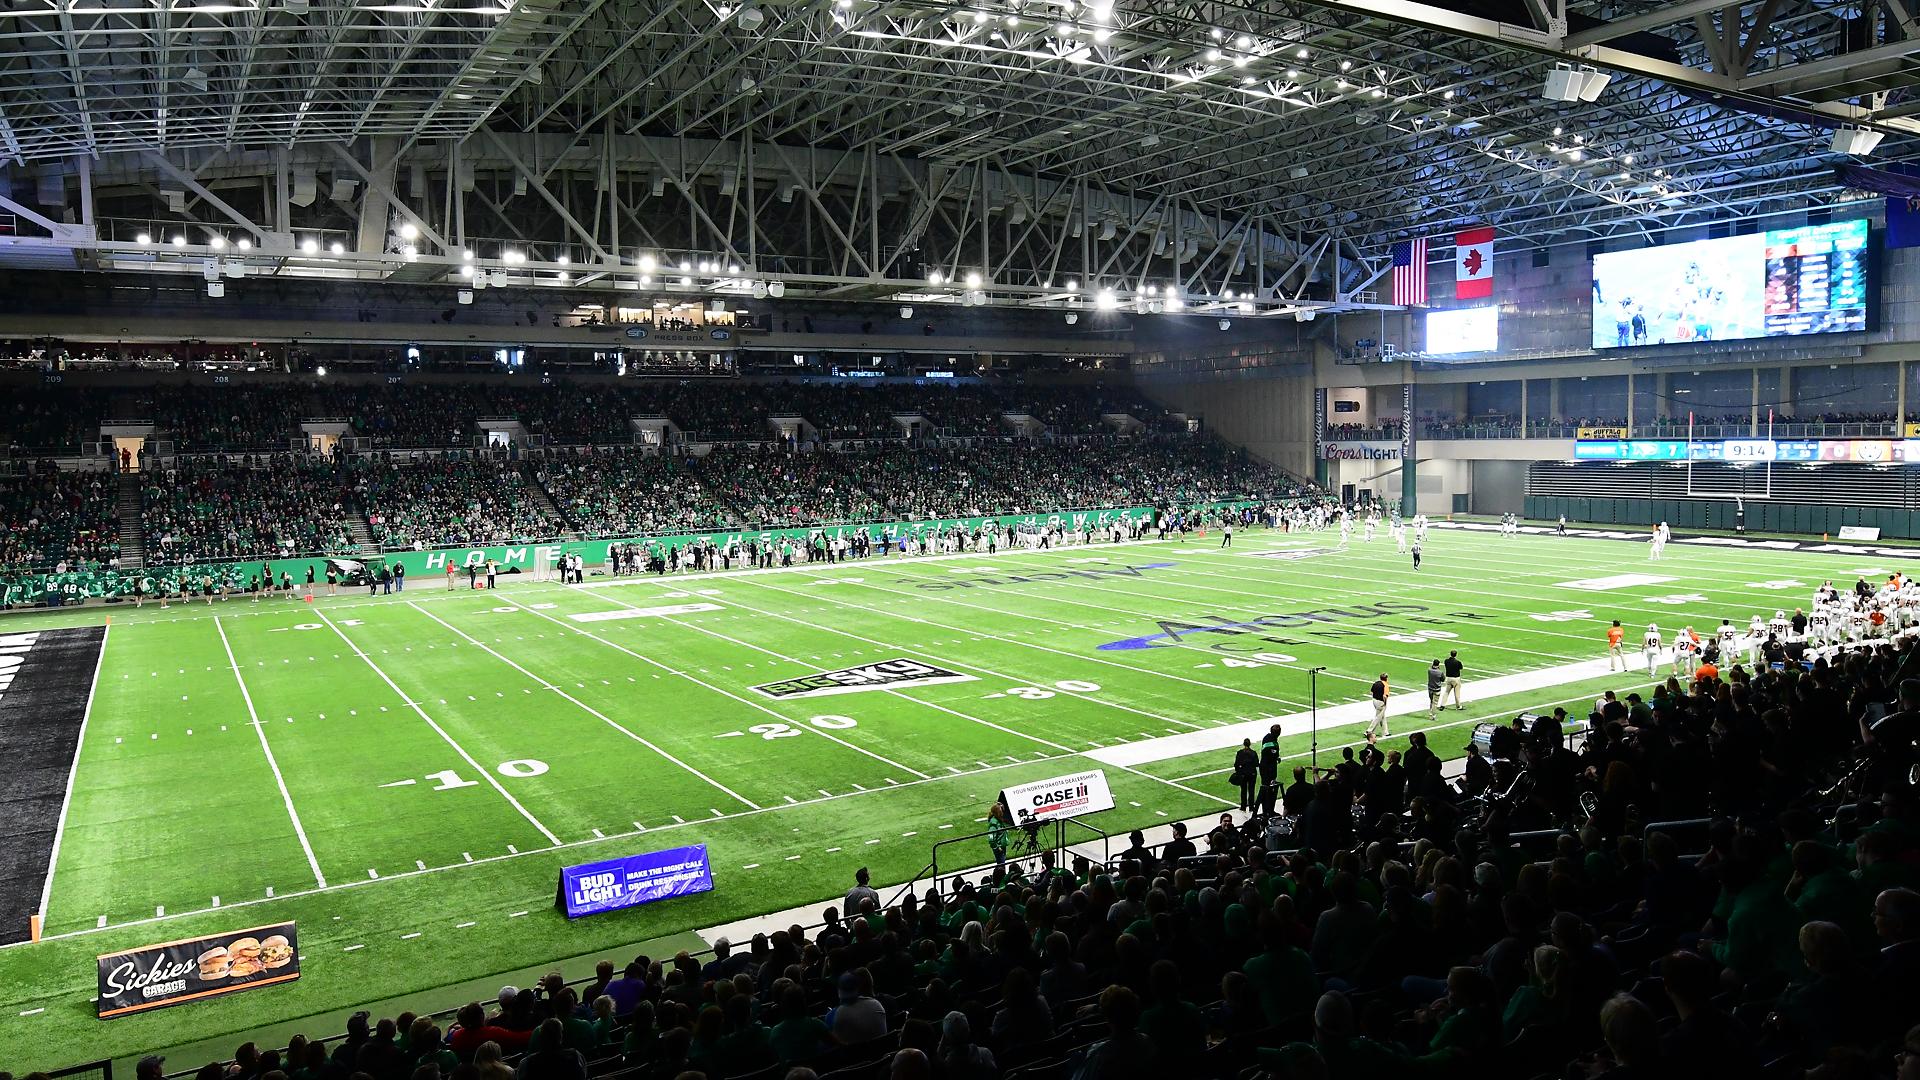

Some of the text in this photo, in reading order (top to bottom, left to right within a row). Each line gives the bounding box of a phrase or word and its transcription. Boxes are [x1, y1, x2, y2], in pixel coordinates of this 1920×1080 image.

[1325, 443, 1398, 460] Coors LIGHT
[1668, 444, 1677, 457] 7
[1733, 445, 1766, 456] 9:14
[426, 546, 562, 569] HOME
[46, 583, 58, 592] 89
[63, 584, 77, 593] 48
[1774, 624, 1783, 632] 28
[1814, 617, 1825, 625] 32
[1209, 612, 1499, 652] CENTER
[1724, 632, 1734, 640] 52
[1648, 638, 1657, 647] 49
[1679, 641, 1689, 650] 27
[1221, 652, 1297, 668] 40
[763, 677, 839, 694] BIG
[826, 660, 935, 686] SKY
[1006, 680, 1101, 699] 30
[748, 714, 858, 740] 20
[425, 759, 549, 791] 10
[1026, 784, 1044, 792] NORTH
[1044, 780, 1064, 788] DAKOTA
[1065, 773, 1098, 784] DEALERSHIPS
[1033, 788, 1074, 806] CASE
[1058, 806, 1089, 817] PRODUCTIVITY
[627, 860, 704, 880] MAKE THE RIGHT CALL
[579, 873, 616, 891] BUD
[628, 870, 705, 891] DRINK RESPONSIBLY
[575, 884, 623, 905] LIGHT
[102, 953, 197, 999] Sickies
[143, 979, 187, 998] GARAGE
